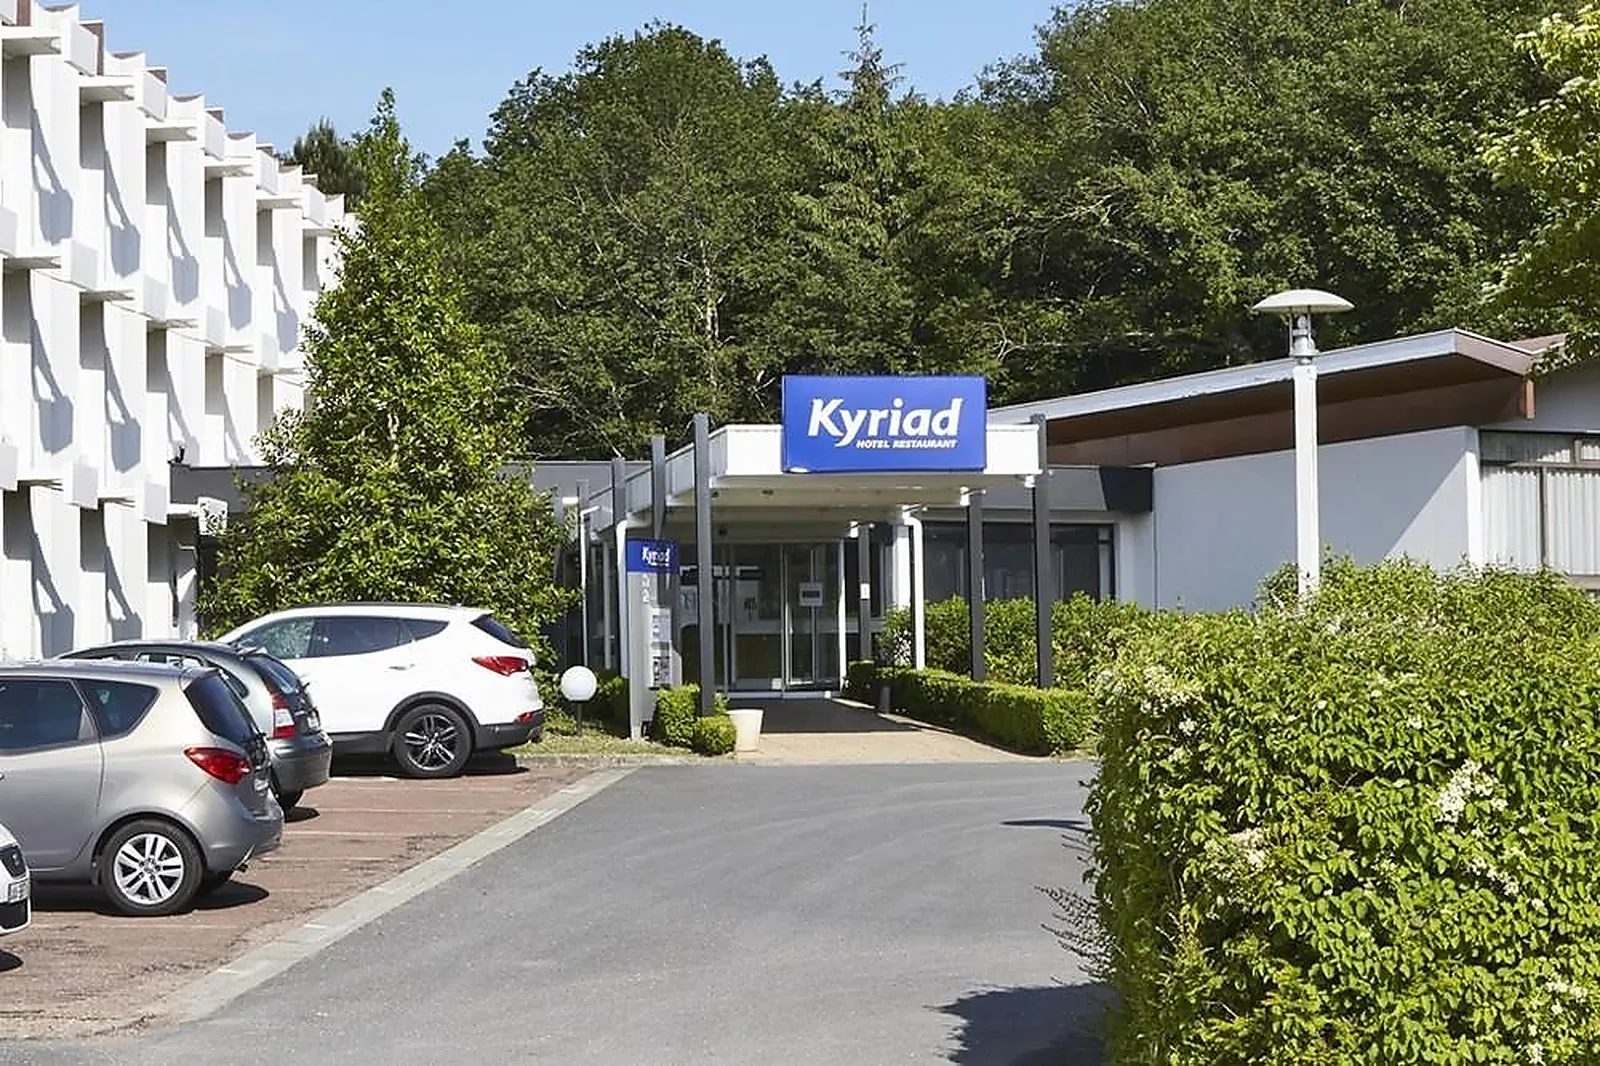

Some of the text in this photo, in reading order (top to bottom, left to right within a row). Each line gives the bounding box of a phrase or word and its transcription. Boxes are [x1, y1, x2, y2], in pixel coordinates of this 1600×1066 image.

[808, 397, 963, 448] Kyriad
[856, 439, 958, 449] HOTEL RESTAURANT
